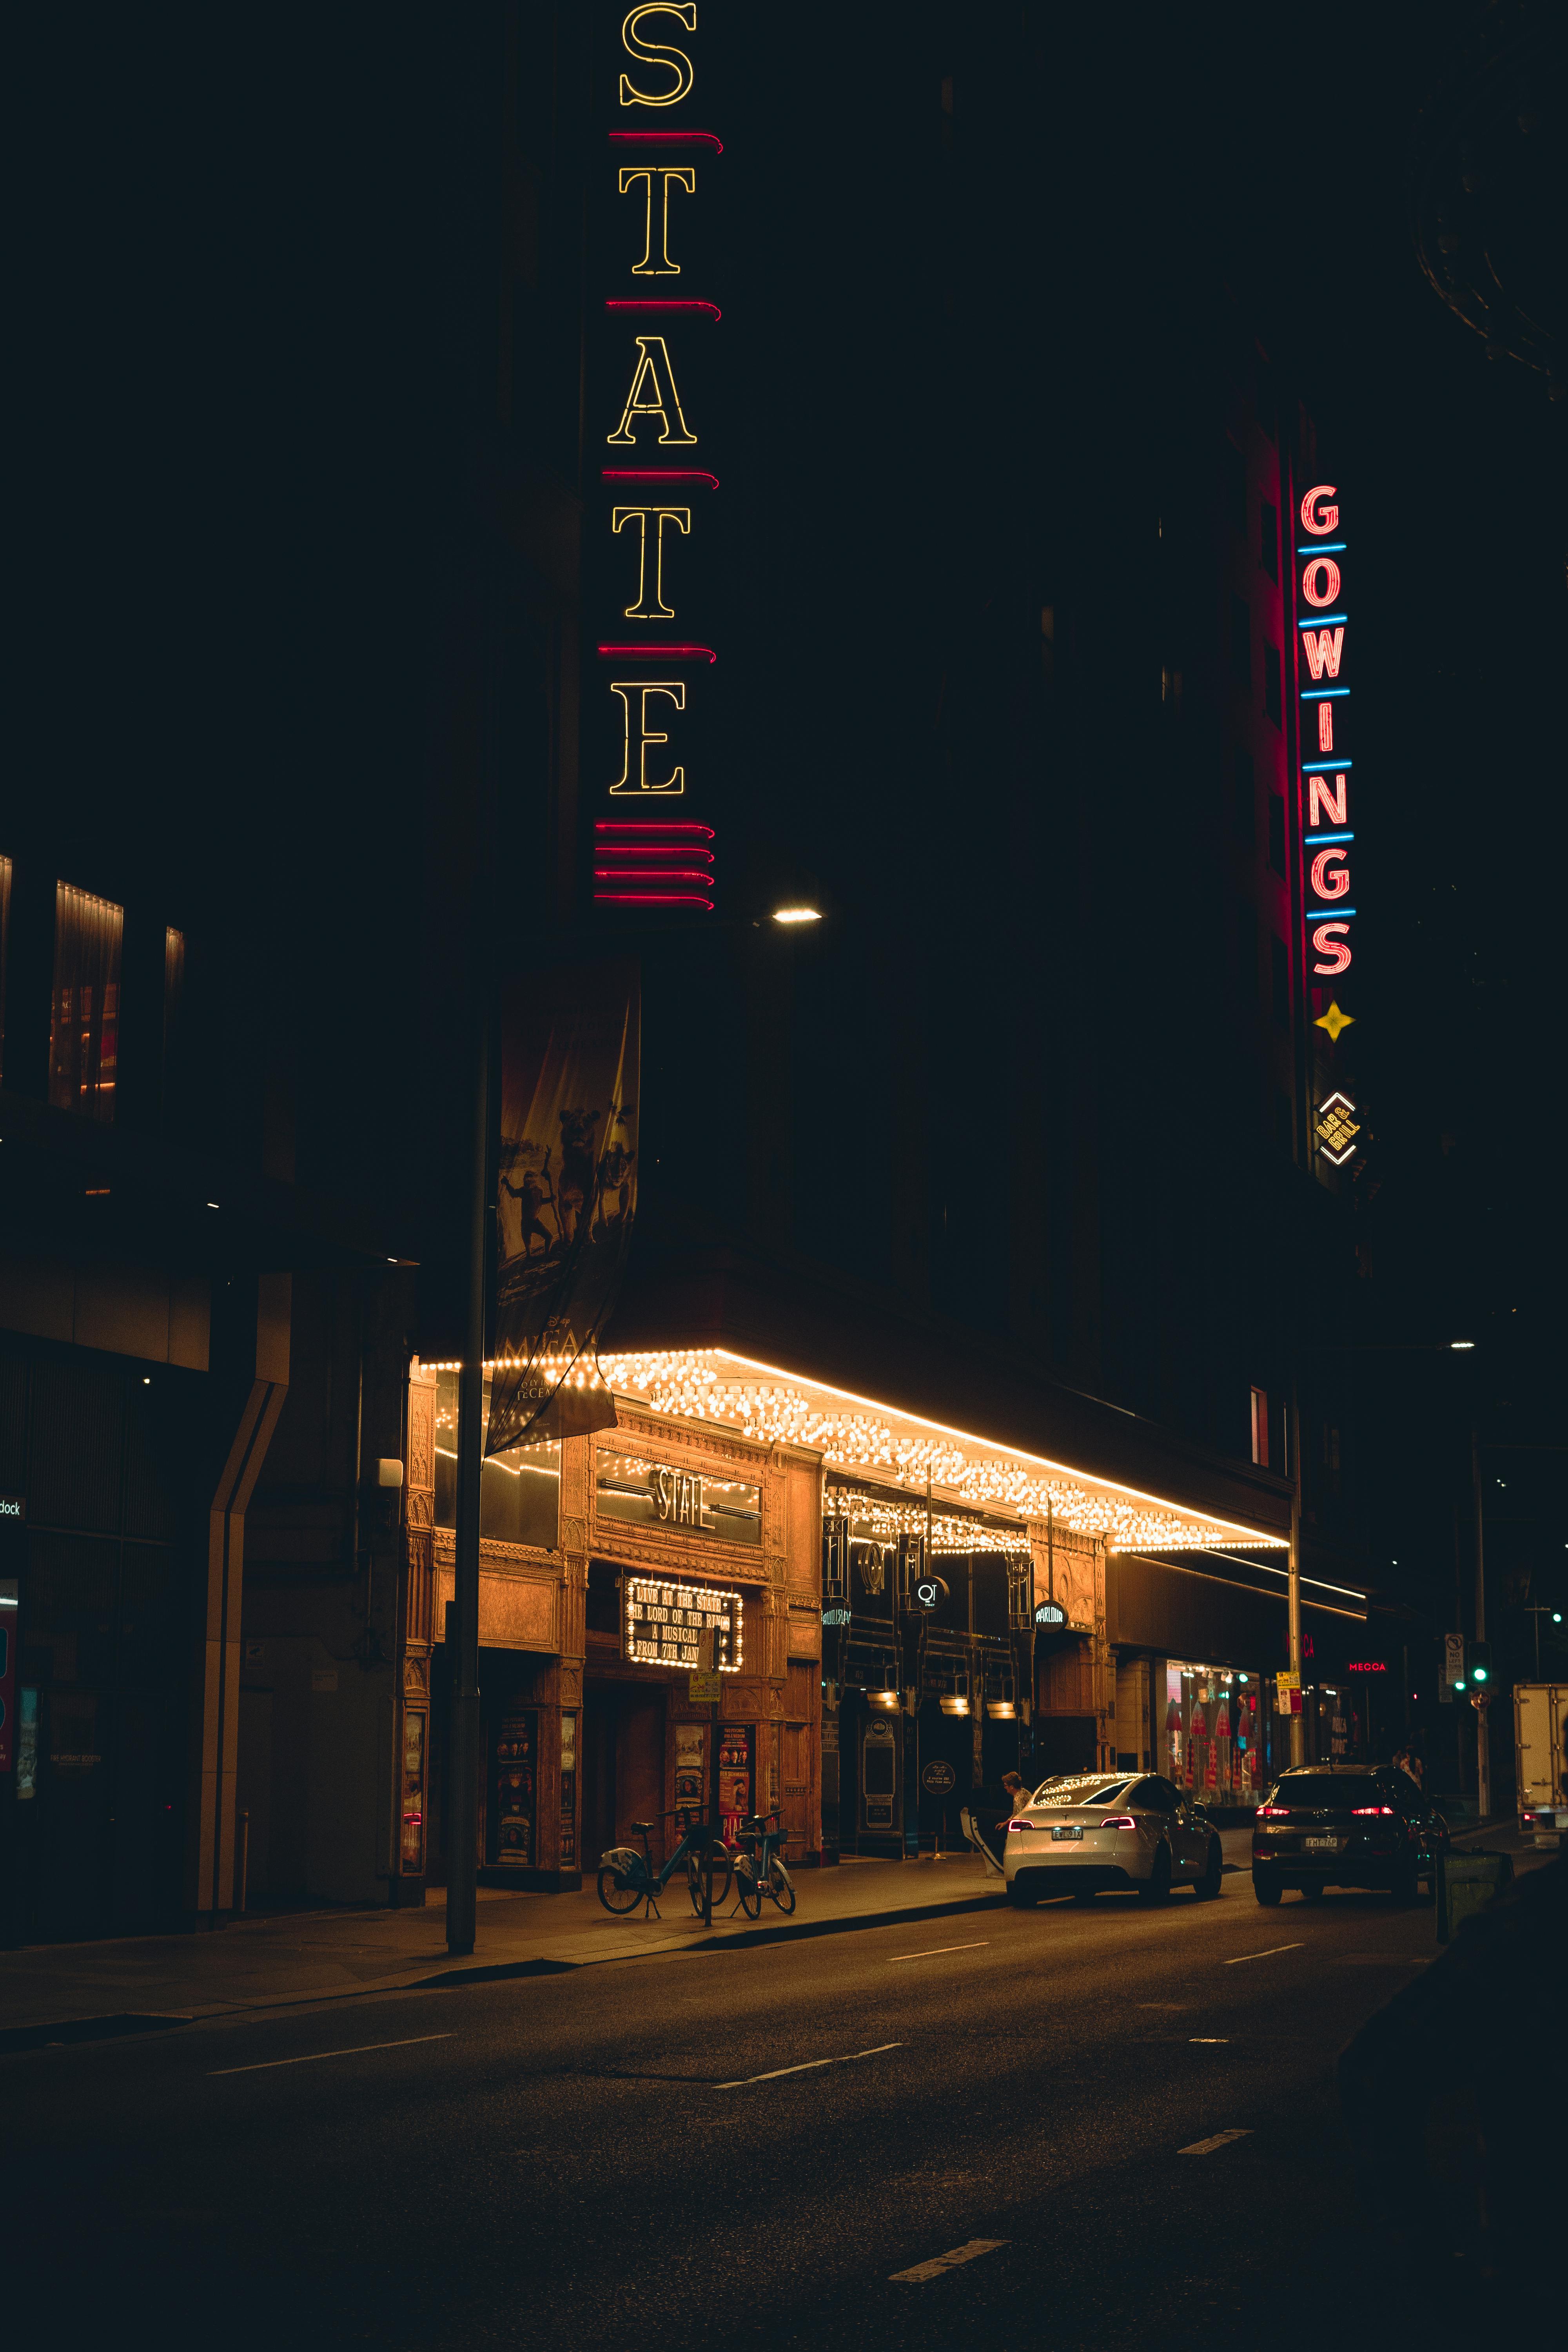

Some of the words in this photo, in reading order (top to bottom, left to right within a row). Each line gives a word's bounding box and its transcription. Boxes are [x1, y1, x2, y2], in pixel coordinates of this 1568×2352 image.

[606, 2, 698, 797] STATE
[1300, 485, 1353, 977] GOWINGS
[1316, 1113, 1341, 1139] BAR
[1334, 1107, 1350, 1120] &
[1328, 1120, 1361, 1151] GRILL
[521, 1379, 538, 1388] OLY
[657, 1469, 716, 1530] STATE
[637, 1586, 658, 1603] LIVE
[662, 1590, 673, 1606] AT
[678, 1592, 692, 1608] THE
[697, 1595, 721, 1612] STATE
[918, 1584, 937, 1603] QT
[647, 1606, 668, 1622] LORD
[672, 1609, 683, 1624] OF
[688, 1612, 702, 1626] THE
[706, 1614, 730, 1631] RINGS
[1036, 1606, 1063, 1623] PARLOUR
[652, 1624, 658, 1639] A
[662, 1625, 697, 1643] MUSICAL
[637, 1641, 657, 1657] FROM
[662, 1643, 677, 1658] 7TH
[1349, 1662, 1386, 1671] MECCA
